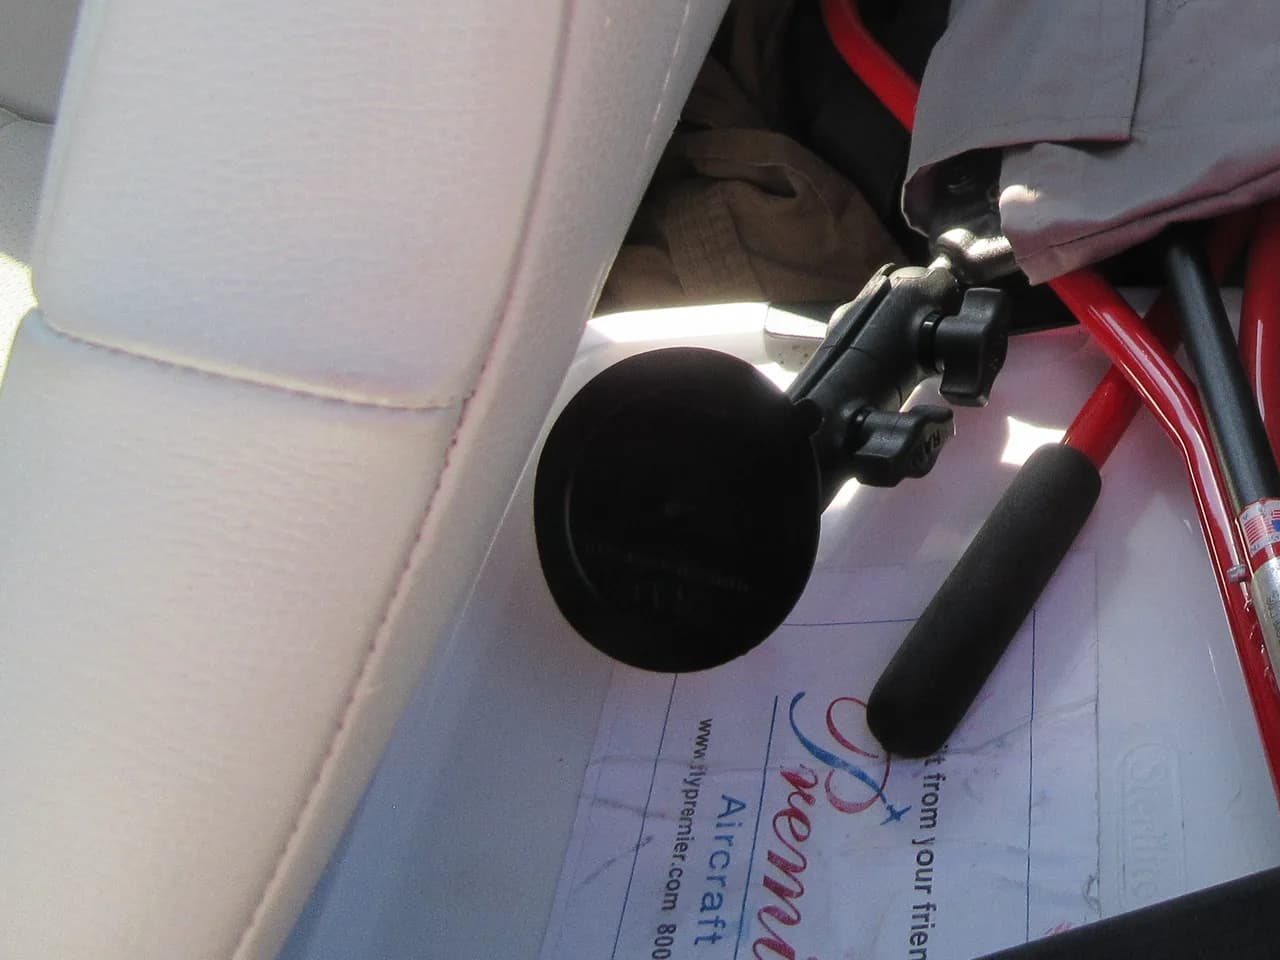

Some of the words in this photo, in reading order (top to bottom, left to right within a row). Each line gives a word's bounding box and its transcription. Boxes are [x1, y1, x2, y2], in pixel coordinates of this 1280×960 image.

[660, 717, 713, 912] www.flypremier.com
[920, 772, 947, 830] from
[694, 793, 747, 946] Aircraft
[911, 836, 936, 895] your
